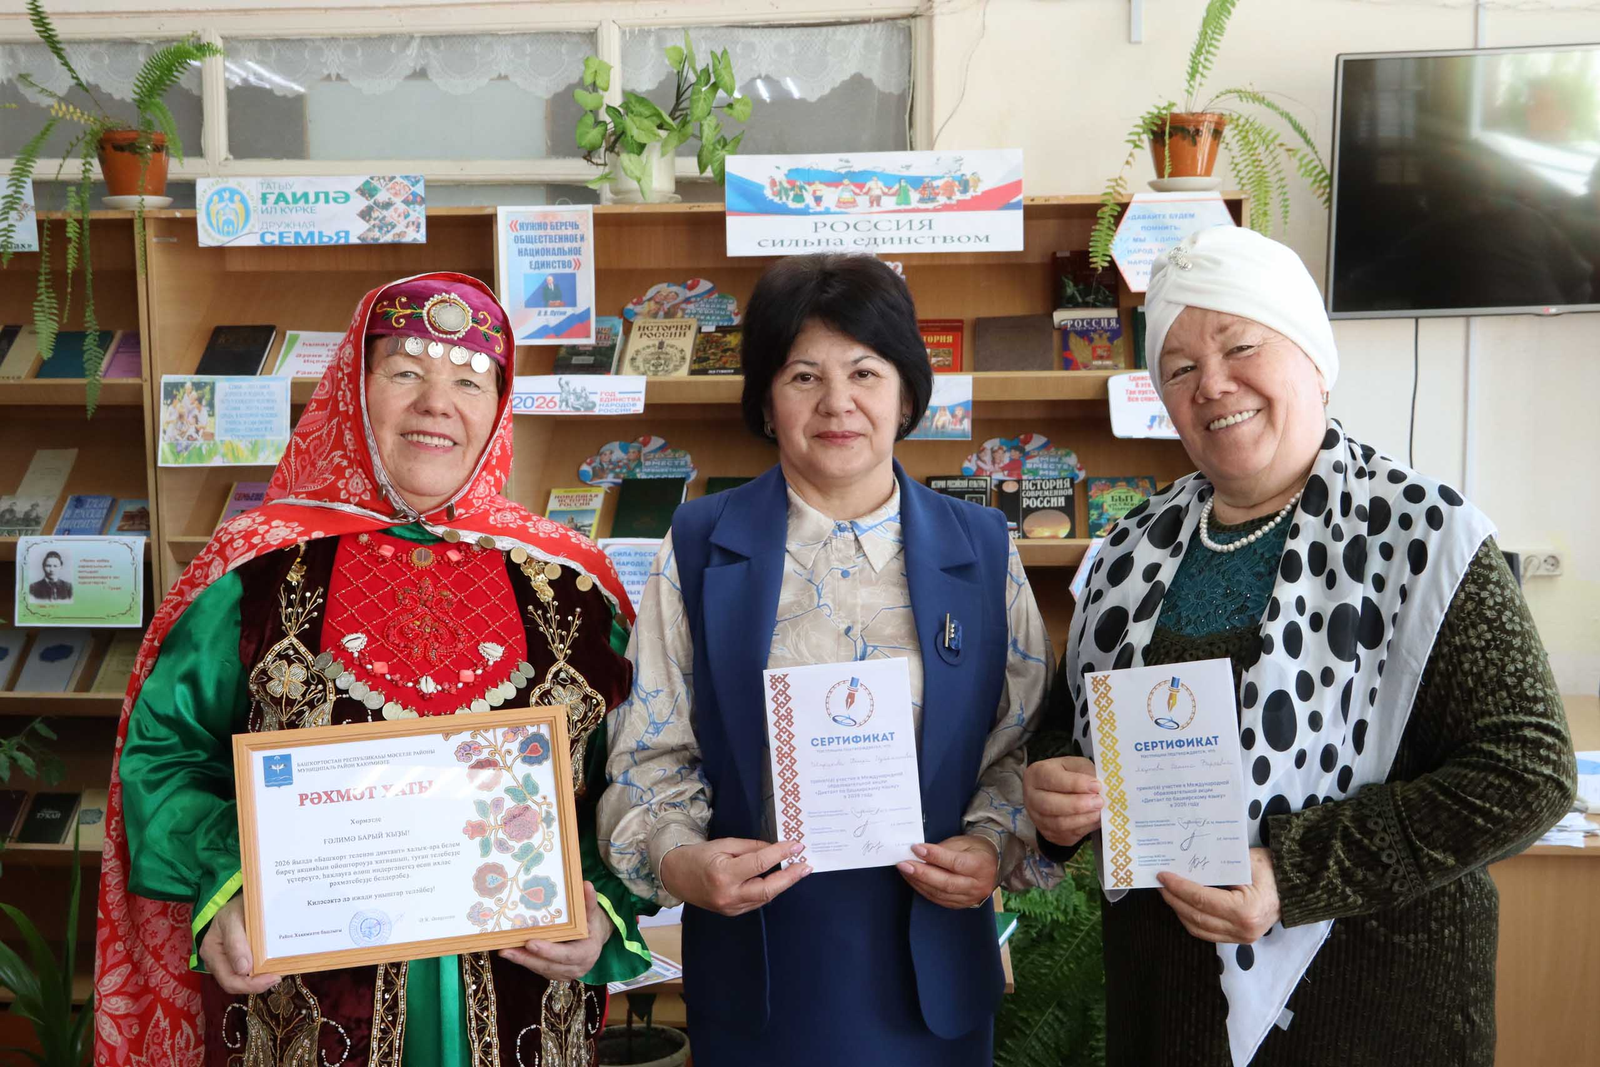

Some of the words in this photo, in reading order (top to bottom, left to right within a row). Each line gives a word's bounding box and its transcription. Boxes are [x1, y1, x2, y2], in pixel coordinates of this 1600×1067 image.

[260, 182, 294, 190] ТАТЫУ
[260, 191, 350, 205] ҒАИЛӘ
[260, 206, 277, 214] ИЛ
[260, 221, 316, 230] ДРУЖНАЯ
[550, 221, 580, 231] БЕРЕЧЬ
[812, 218, 934, 233] РОССИЯ
[260, 230, 350, 245] СЕМЬЯ
[514, 234, 578, 245] ОБЩЕСТВЕННОЕ
[579, 234, 585, 243] И
[757, 237, 844, 248] сильна
[853, 234, 991, 248] единством
[517, 247, 582, 257] НАЦИОНАЛЬНОЕ
[638, 324, 692, 332] ИСТОРИЯ
[923, 335, 953, 343] ТОРИЯ
[513, 395, 557, 409] 2026
[1022, 478, 1071, 490] ИСТОРИЯ
[1022, 489, 1073, 497] СОВРЕМЕННОЙ
[1023, 497, 1065, 508] РОССИИ
[811, 732, 895, 747] СЕРТИФИКАТ
[1134, 736, 1219, 752] СЕРТИФИКАТ
[297, 764, 336, 773] МУНИЦИПАЛЬ
[337, 762, 355, 770] РАЙОН
[1187, 780, 1229, 788] Международной
[298, 786, 377, 807] РӘХМӘТ
[358, 832, 383, 841] БАРЫЙ
[307, 897, 341, 906] Киләсәктә
